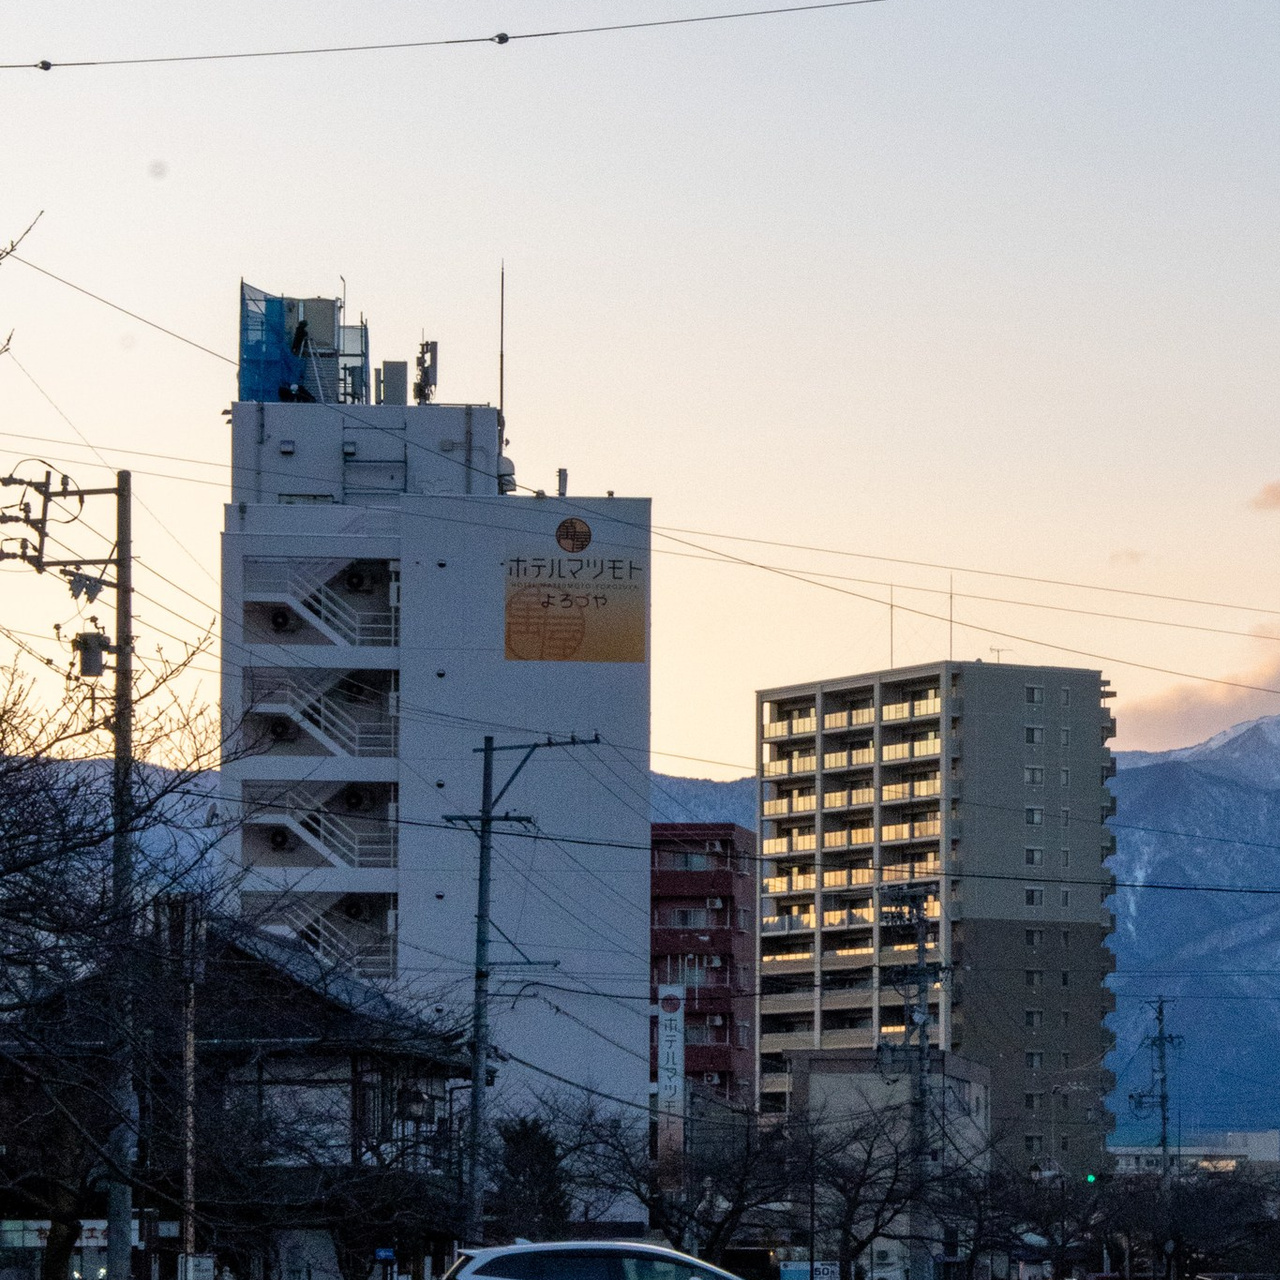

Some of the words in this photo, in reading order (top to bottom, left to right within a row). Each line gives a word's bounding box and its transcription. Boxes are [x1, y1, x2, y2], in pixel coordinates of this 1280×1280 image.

[509, 557, 643, 580] ホテルマツモト
[541, 593, 608, 609] よろづや
[664, 1017, 678, 1130] ホテルマツモト
